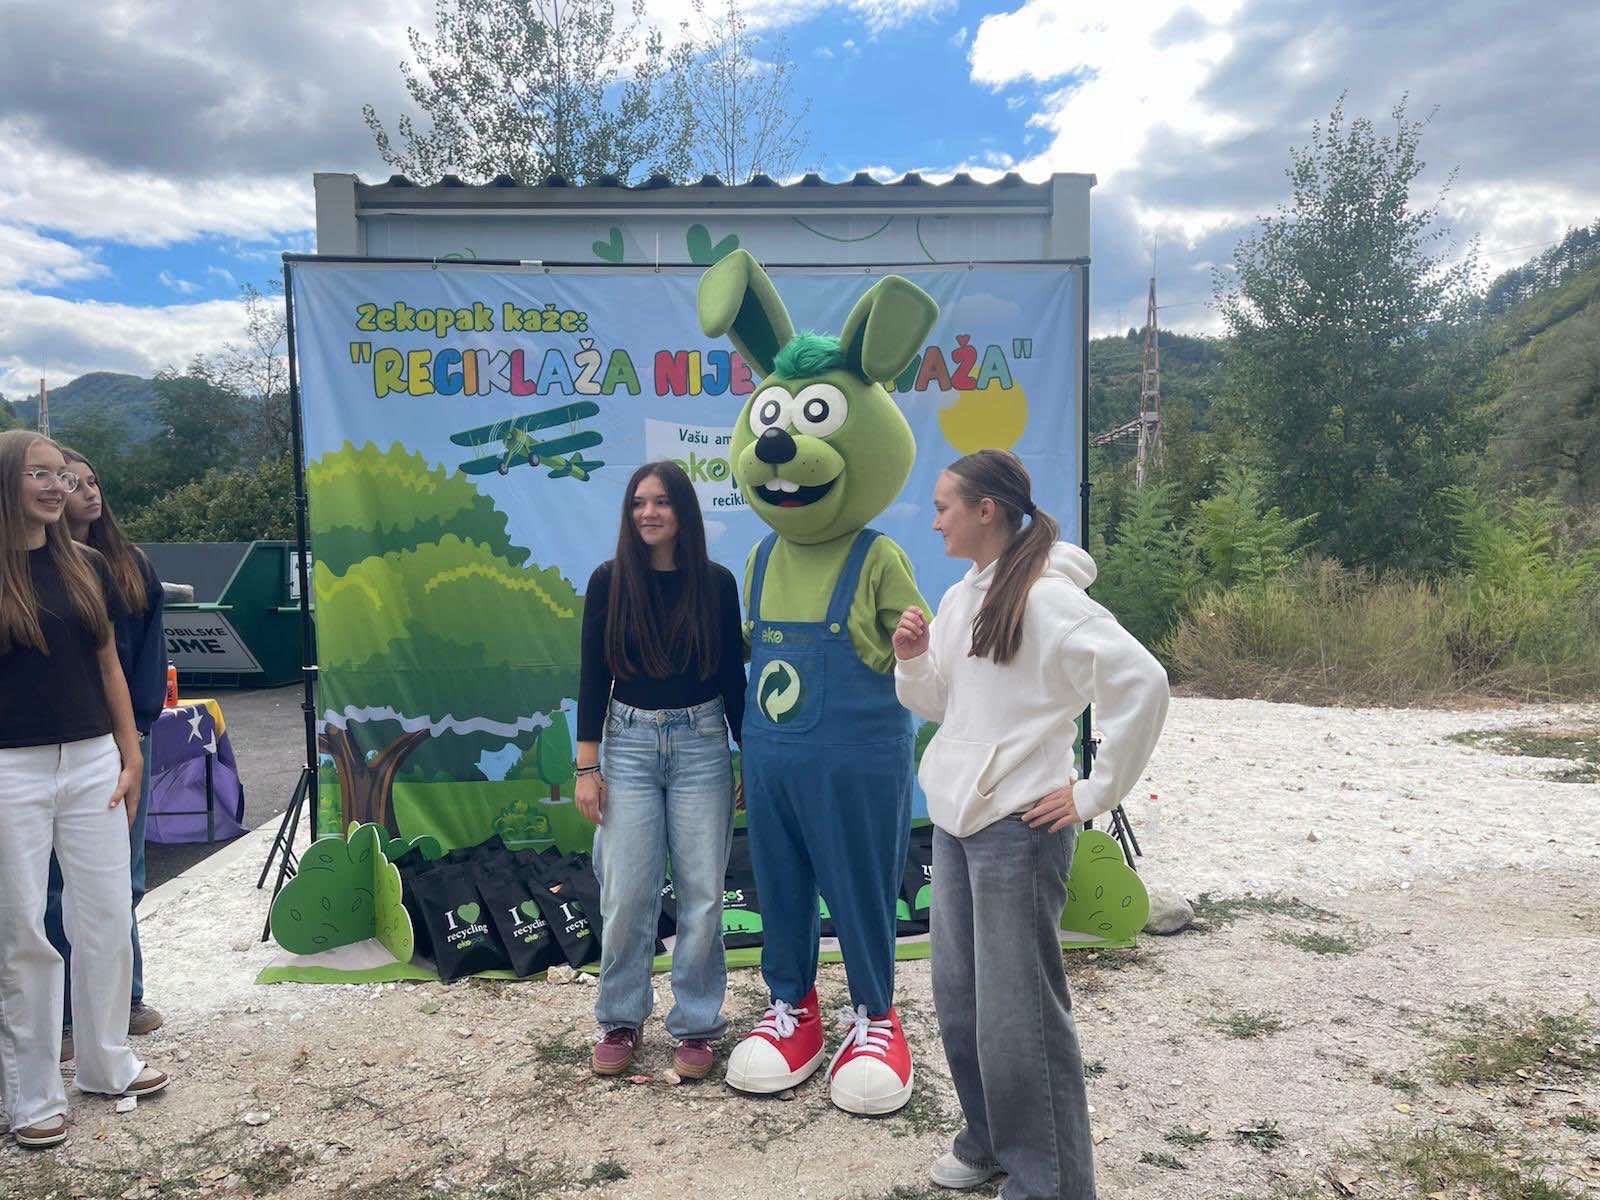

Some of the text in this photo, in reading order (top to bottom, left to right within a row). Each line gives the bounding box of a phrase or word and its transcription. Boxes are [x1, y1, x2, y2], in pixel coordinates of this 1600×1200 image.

[356, 301, 589, 338] Zekopak kaže:
[654, 350, 756, 397] NIJE
[679, 428, 709, 444] Vašu
[444, 909, 458, 931] I
[508, 906, 524, 927] I
[559, 902, 575, 922] I
[447, 924, 489, 943] recycling
